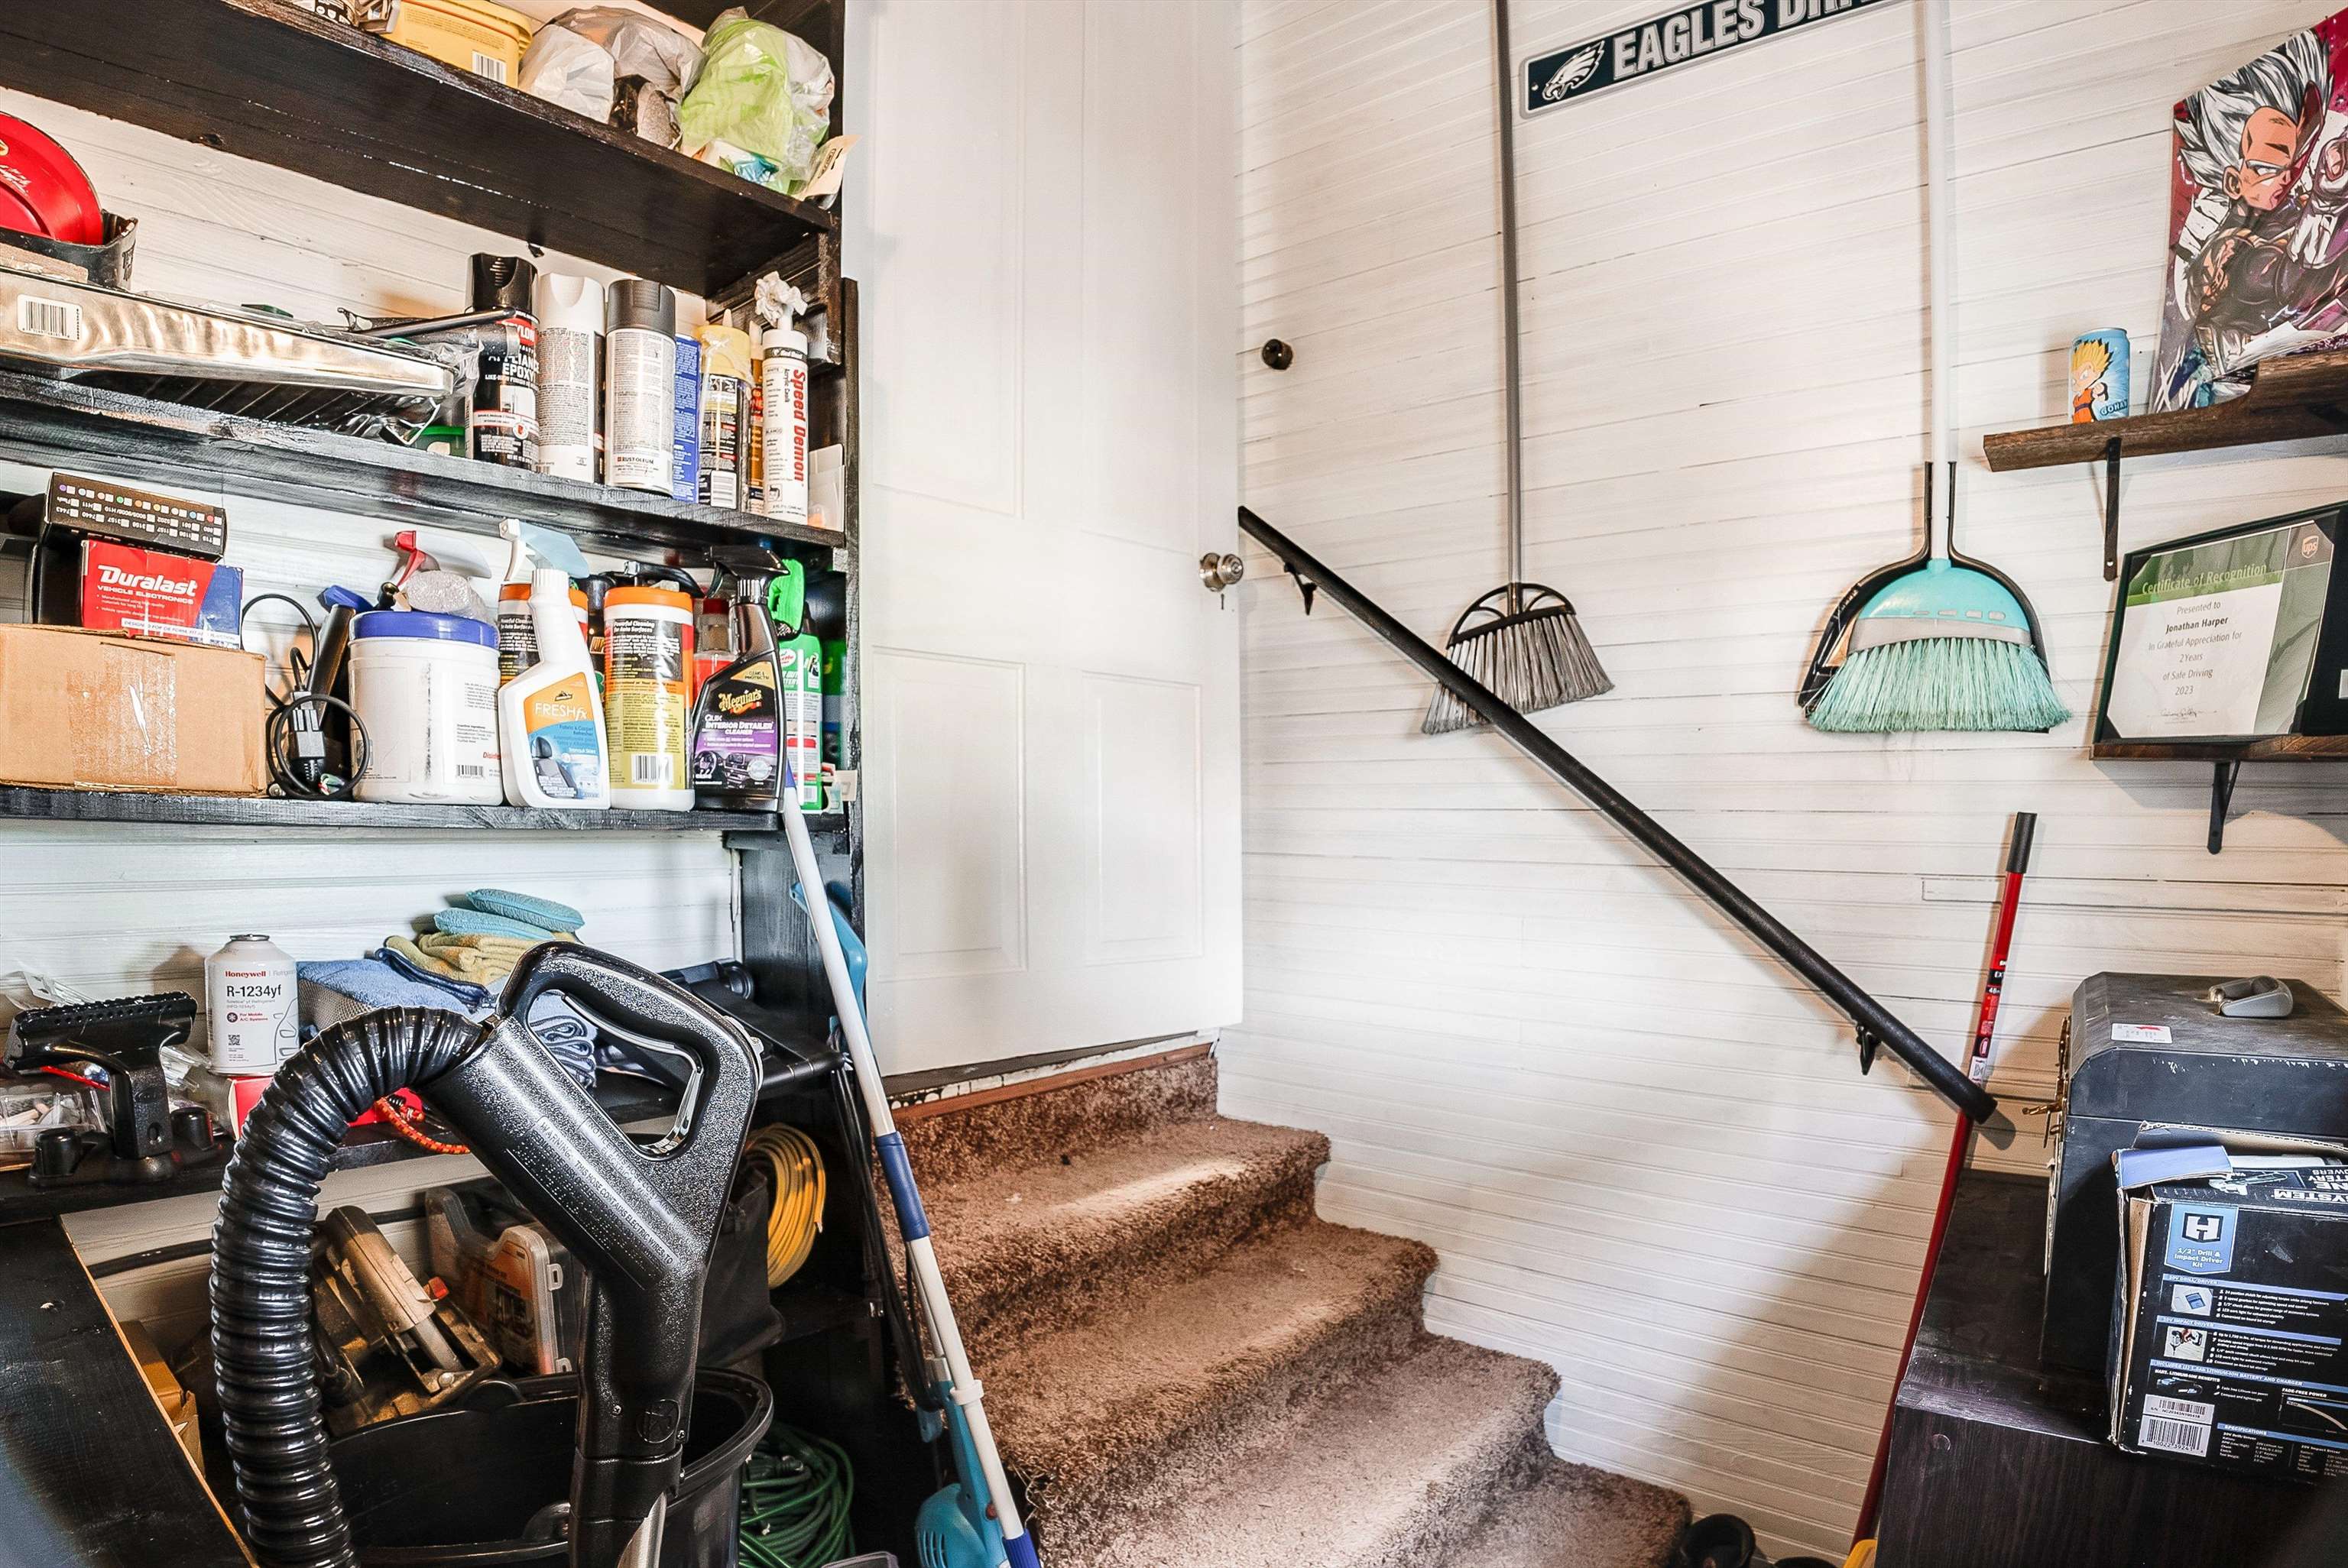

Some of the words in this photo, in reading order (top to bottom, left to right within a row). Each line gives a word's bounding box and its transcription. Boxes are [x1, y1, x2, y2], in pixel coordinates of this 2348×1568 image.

[1613, 0, 1765, 81] EAGLES
[502, 363, 535, 382] EPOXY
[790, 369, 806, 423] Speed
[793, 425, 806, 482] Demon
[98, 565, 198, 597] Duralast
[2142, 578, 2191, 594] Certificate
[2193, 572, 2204, 585] of
[2207, 563, 2267, 586] Recognition
[98, 585, 133, 595] VEHICLE
[135, 591, 193, 605] ELECTRONICS
[2177, 603, 2212, 615] Presented
[2213, 600, 2221, 609] to
[124, 620, 152, 629] DESIGND
[2165, 621, 2200, 634] Jonathan
[2201, 617, 2229, 628] Harper
[2157, 637, 2184, 650] Grateful
[2185, 633, 2230, 649] Appreciation
[2232, 630, 2243, 640] for
[2162, 672, 2170, 681] of
[2171, 669, 2186, 680] Safe
[2187, 667, 2213, 679] Driving
[2175, 685, 2194, 696] 2023
[718, 688, 762, 712] Meguiar's
[705, 721, 738, 730] INTERIOR
[739, 722, 773, 731] DETAILER
[225, 970, 266, 979] Honeywell
[226, 983, 281, 999] R-1234yf
[2308, 1174, 2348, 1183] TTERY
[2314, 1181, 2348, 1191] NE
[2275, 1189, 2348, 1204] YSTEM
[573, 1160, 590, 1178] THIS
[585, 1173, 604, 1191] HOSE
[599, 1187, 628, 1218] CONTAINS
[624, 1213, 650, 1241] ELECTRIC
[663, 1254, 674, 1265] TO
[2174, 1253, 2198, 1262] Impact
[2201, 1255, 2223, 1264] Driver
[2276, 1378, 2302, 1386] CHARGER
